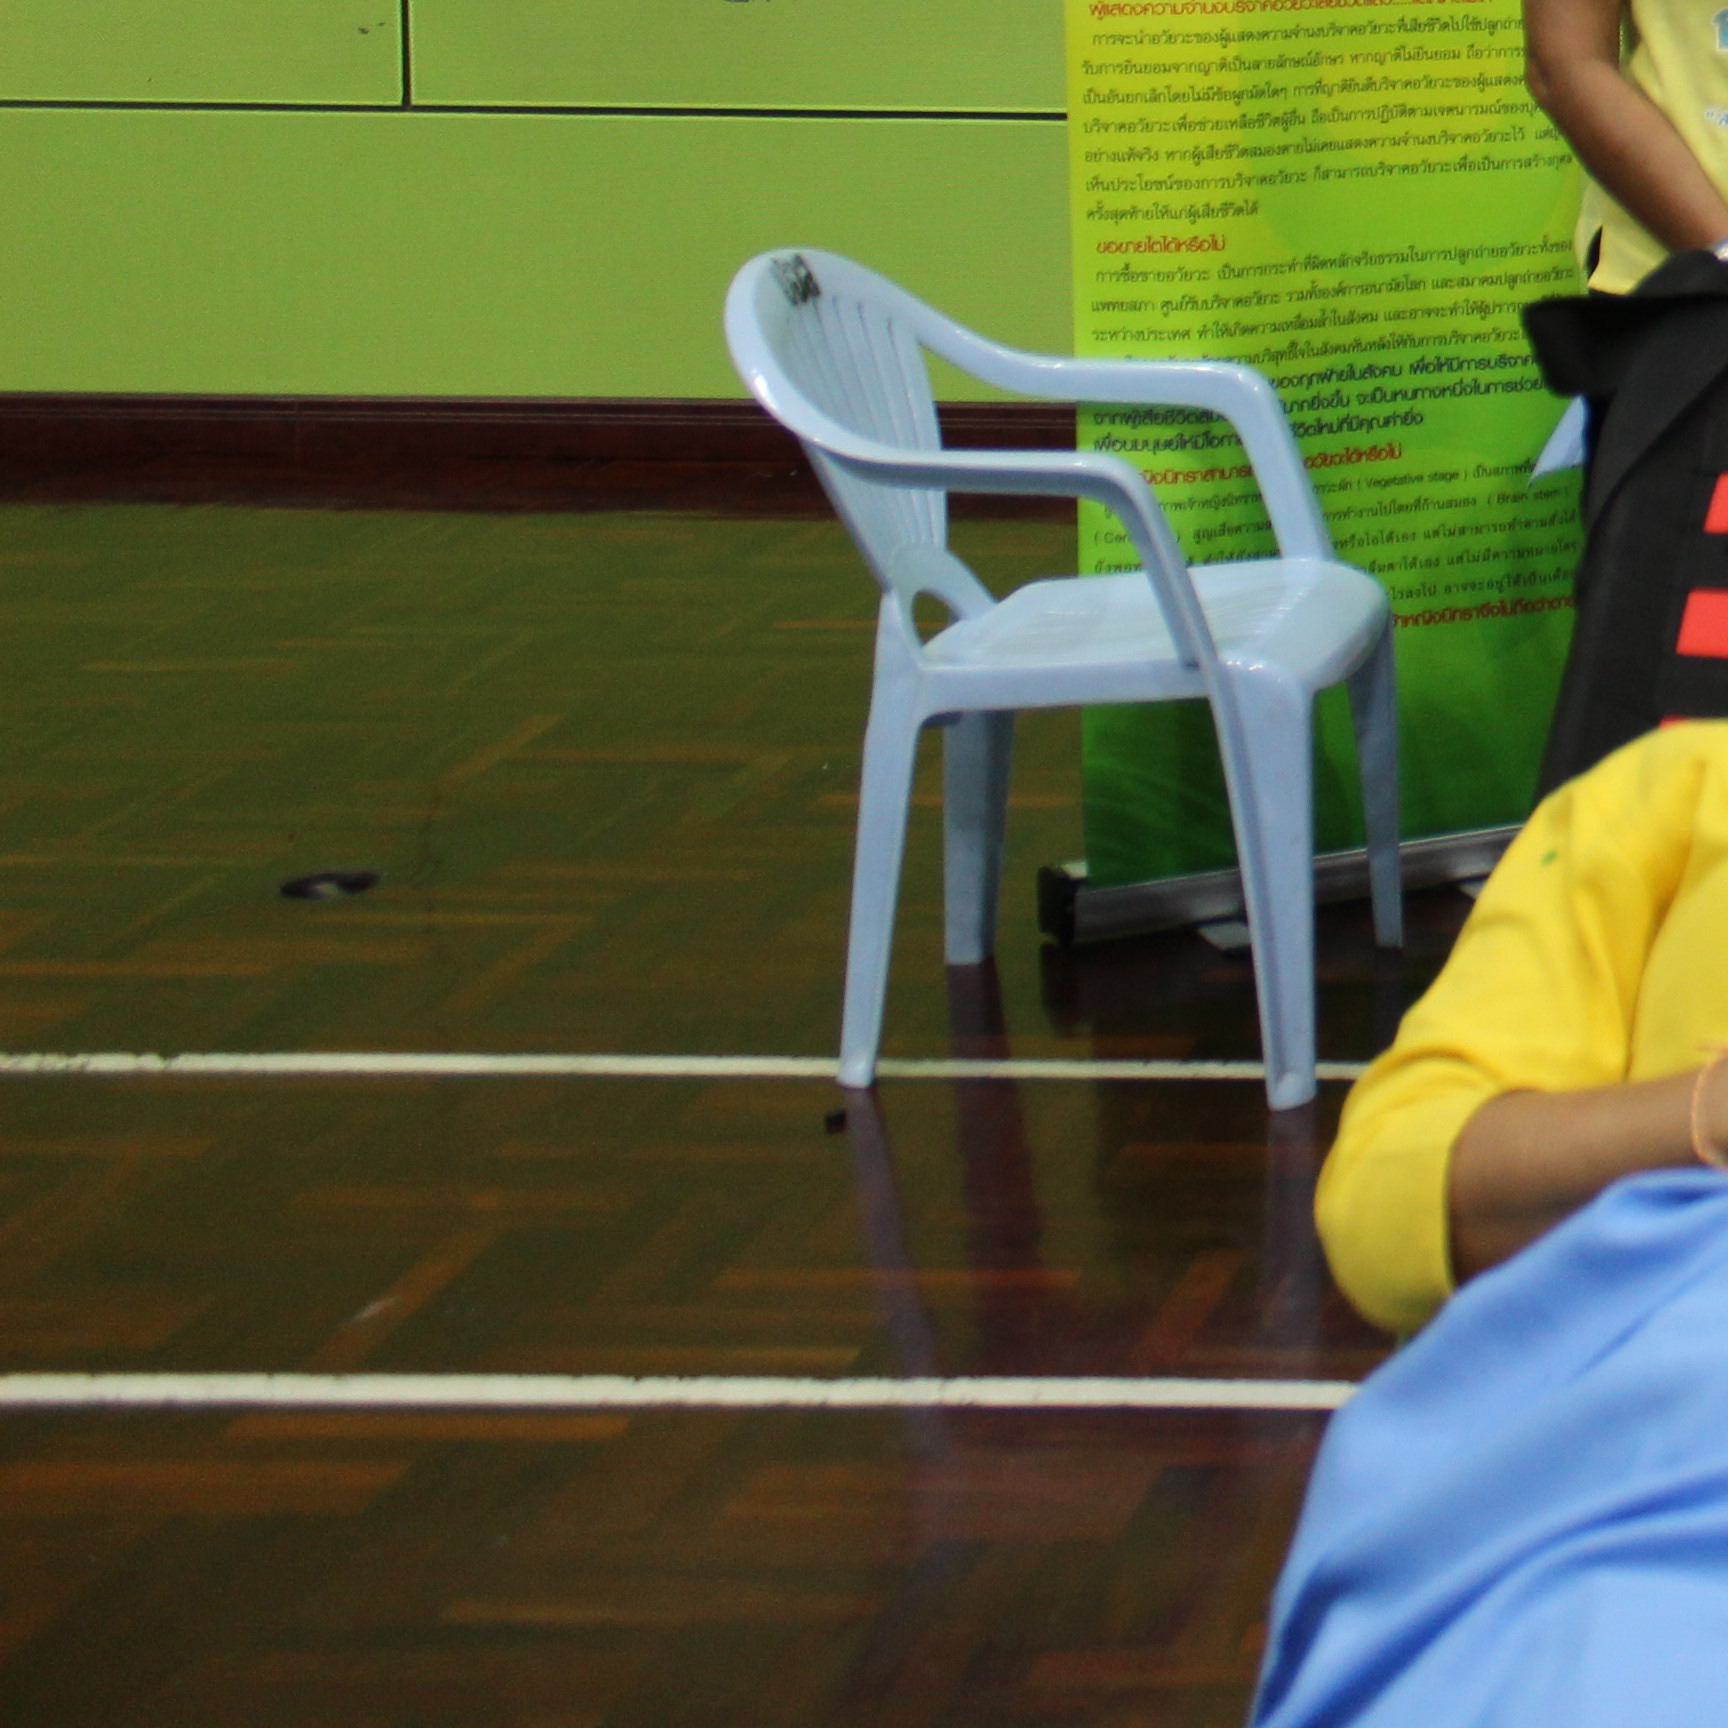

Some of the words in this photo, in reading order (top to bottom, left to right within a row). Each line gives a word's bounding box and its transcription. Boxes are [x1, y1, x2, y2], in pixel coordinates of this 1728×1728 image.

[1097, 233, 1226, 255] ขอขายไตได้หรือไม่
